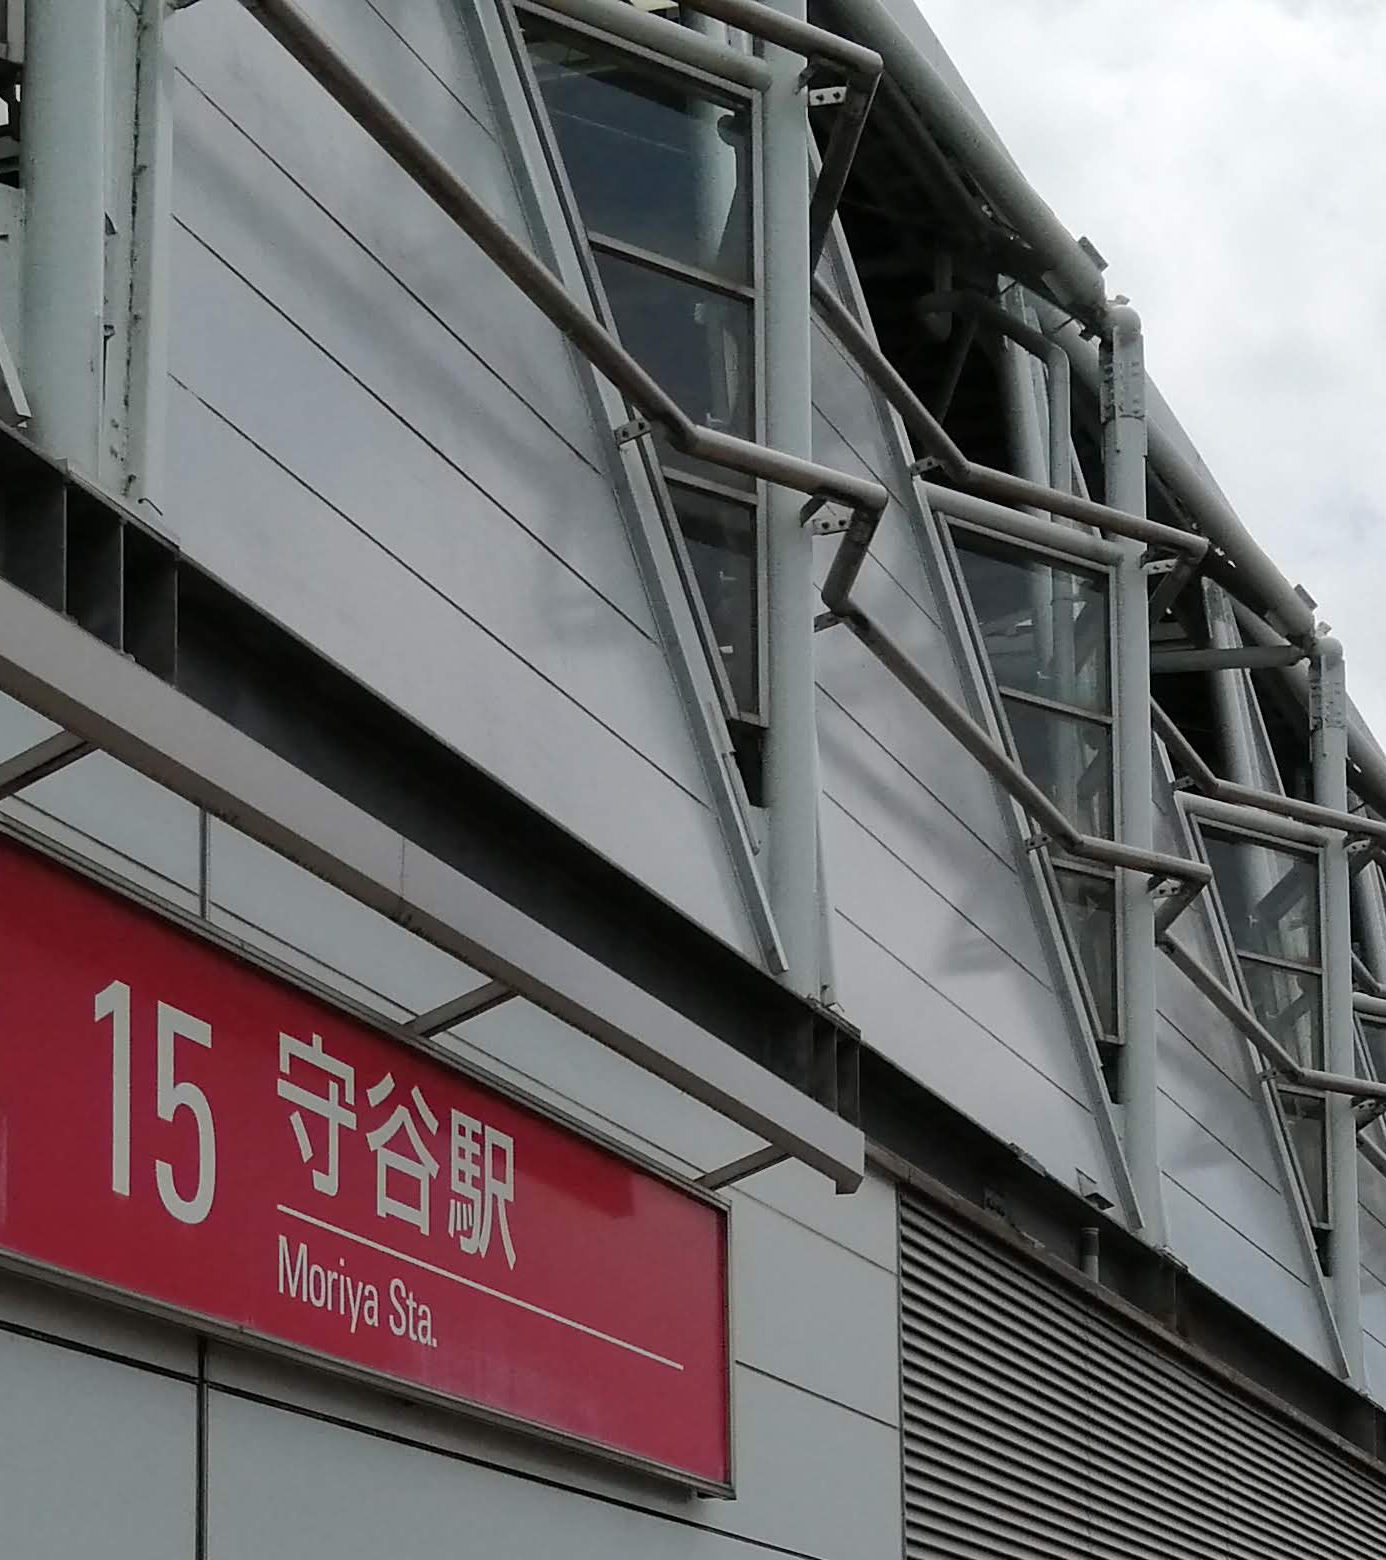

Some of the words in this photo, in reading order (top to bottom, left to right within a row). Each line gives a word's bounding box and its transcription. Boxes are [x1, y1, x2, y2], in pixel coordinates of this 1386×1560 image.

[94, 979, 216, 1225] 15
[276, 1031, 517, 1271] 守谷駅
[278, 1234, 380, 1334] Moriya
[388, 1278, 439, 1348] Sta.
